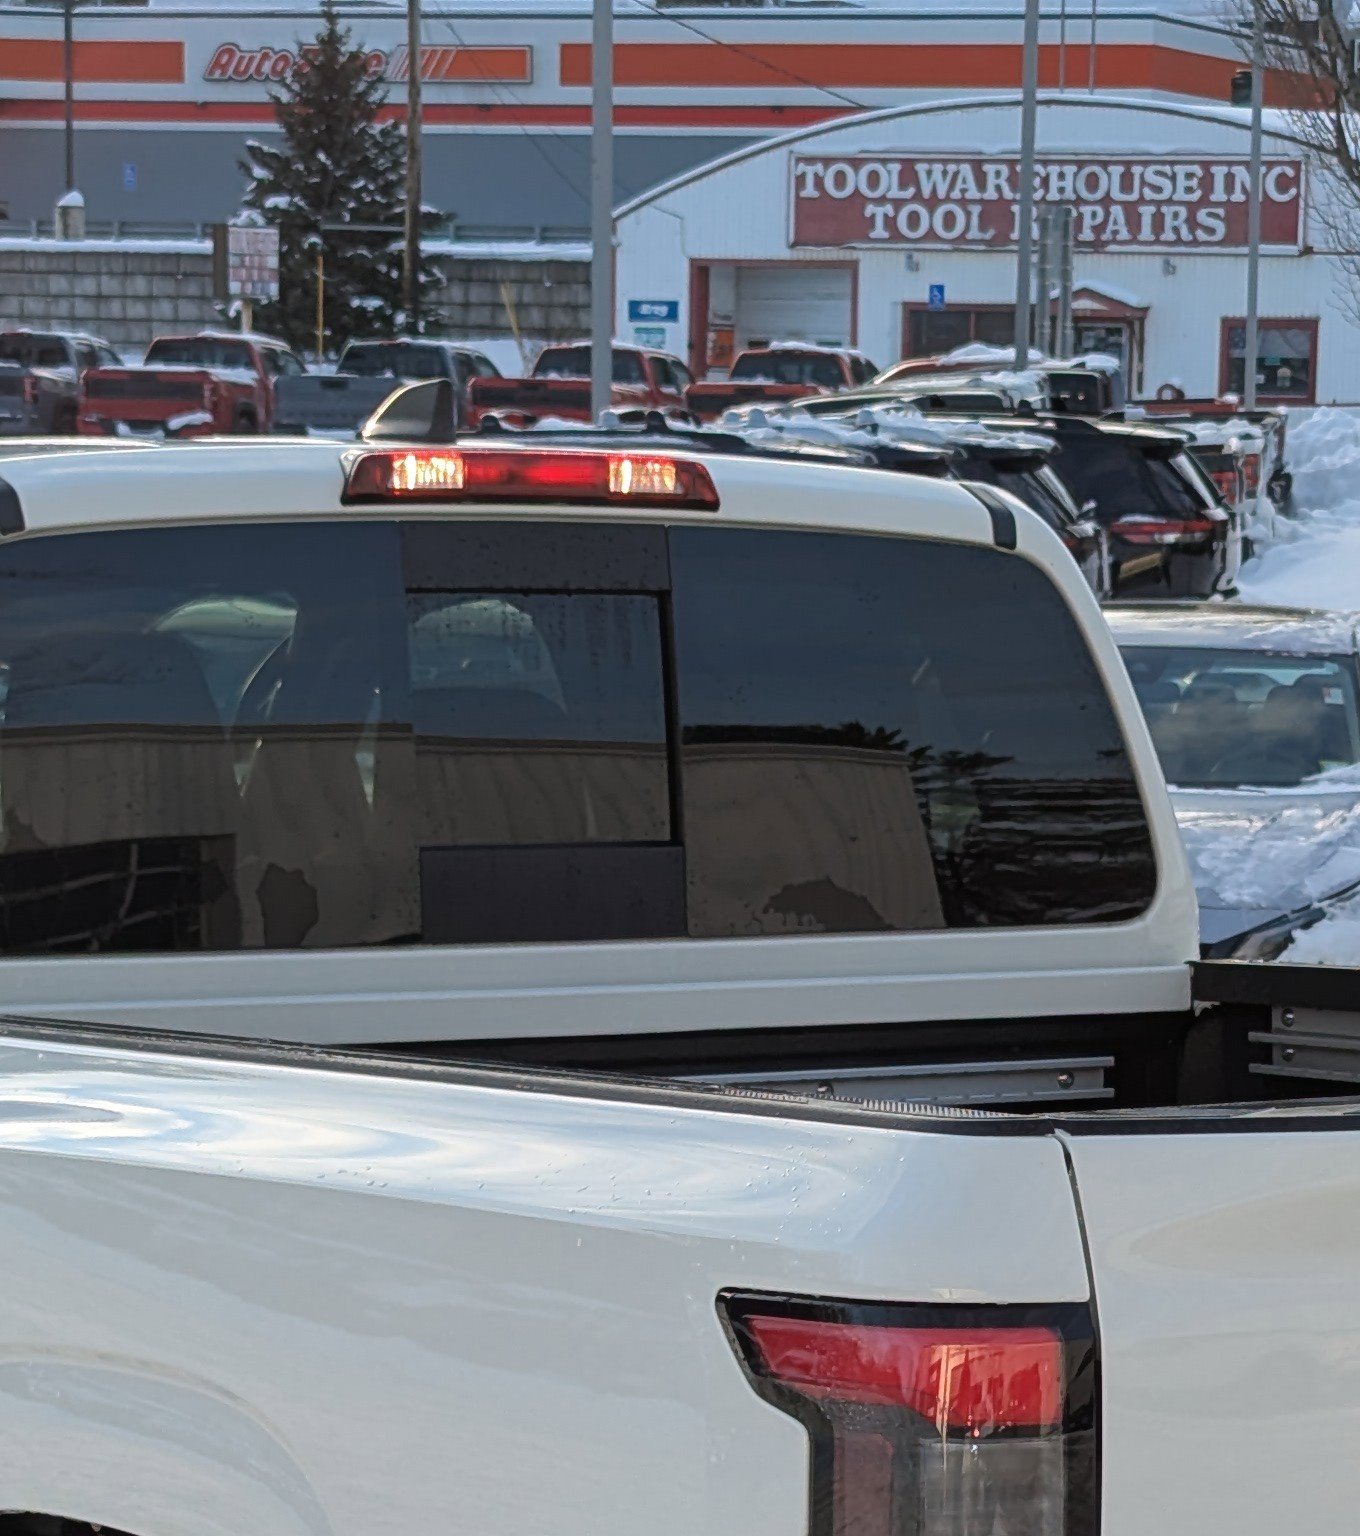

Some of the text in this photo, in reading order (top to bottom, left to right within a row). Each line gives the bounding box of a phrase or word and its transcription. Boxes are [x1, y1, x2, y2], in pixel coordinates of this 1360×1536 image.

[1209, 165, 1297, 202] INC
[864, 202, 1226, 243] TOOL RPAIRS
